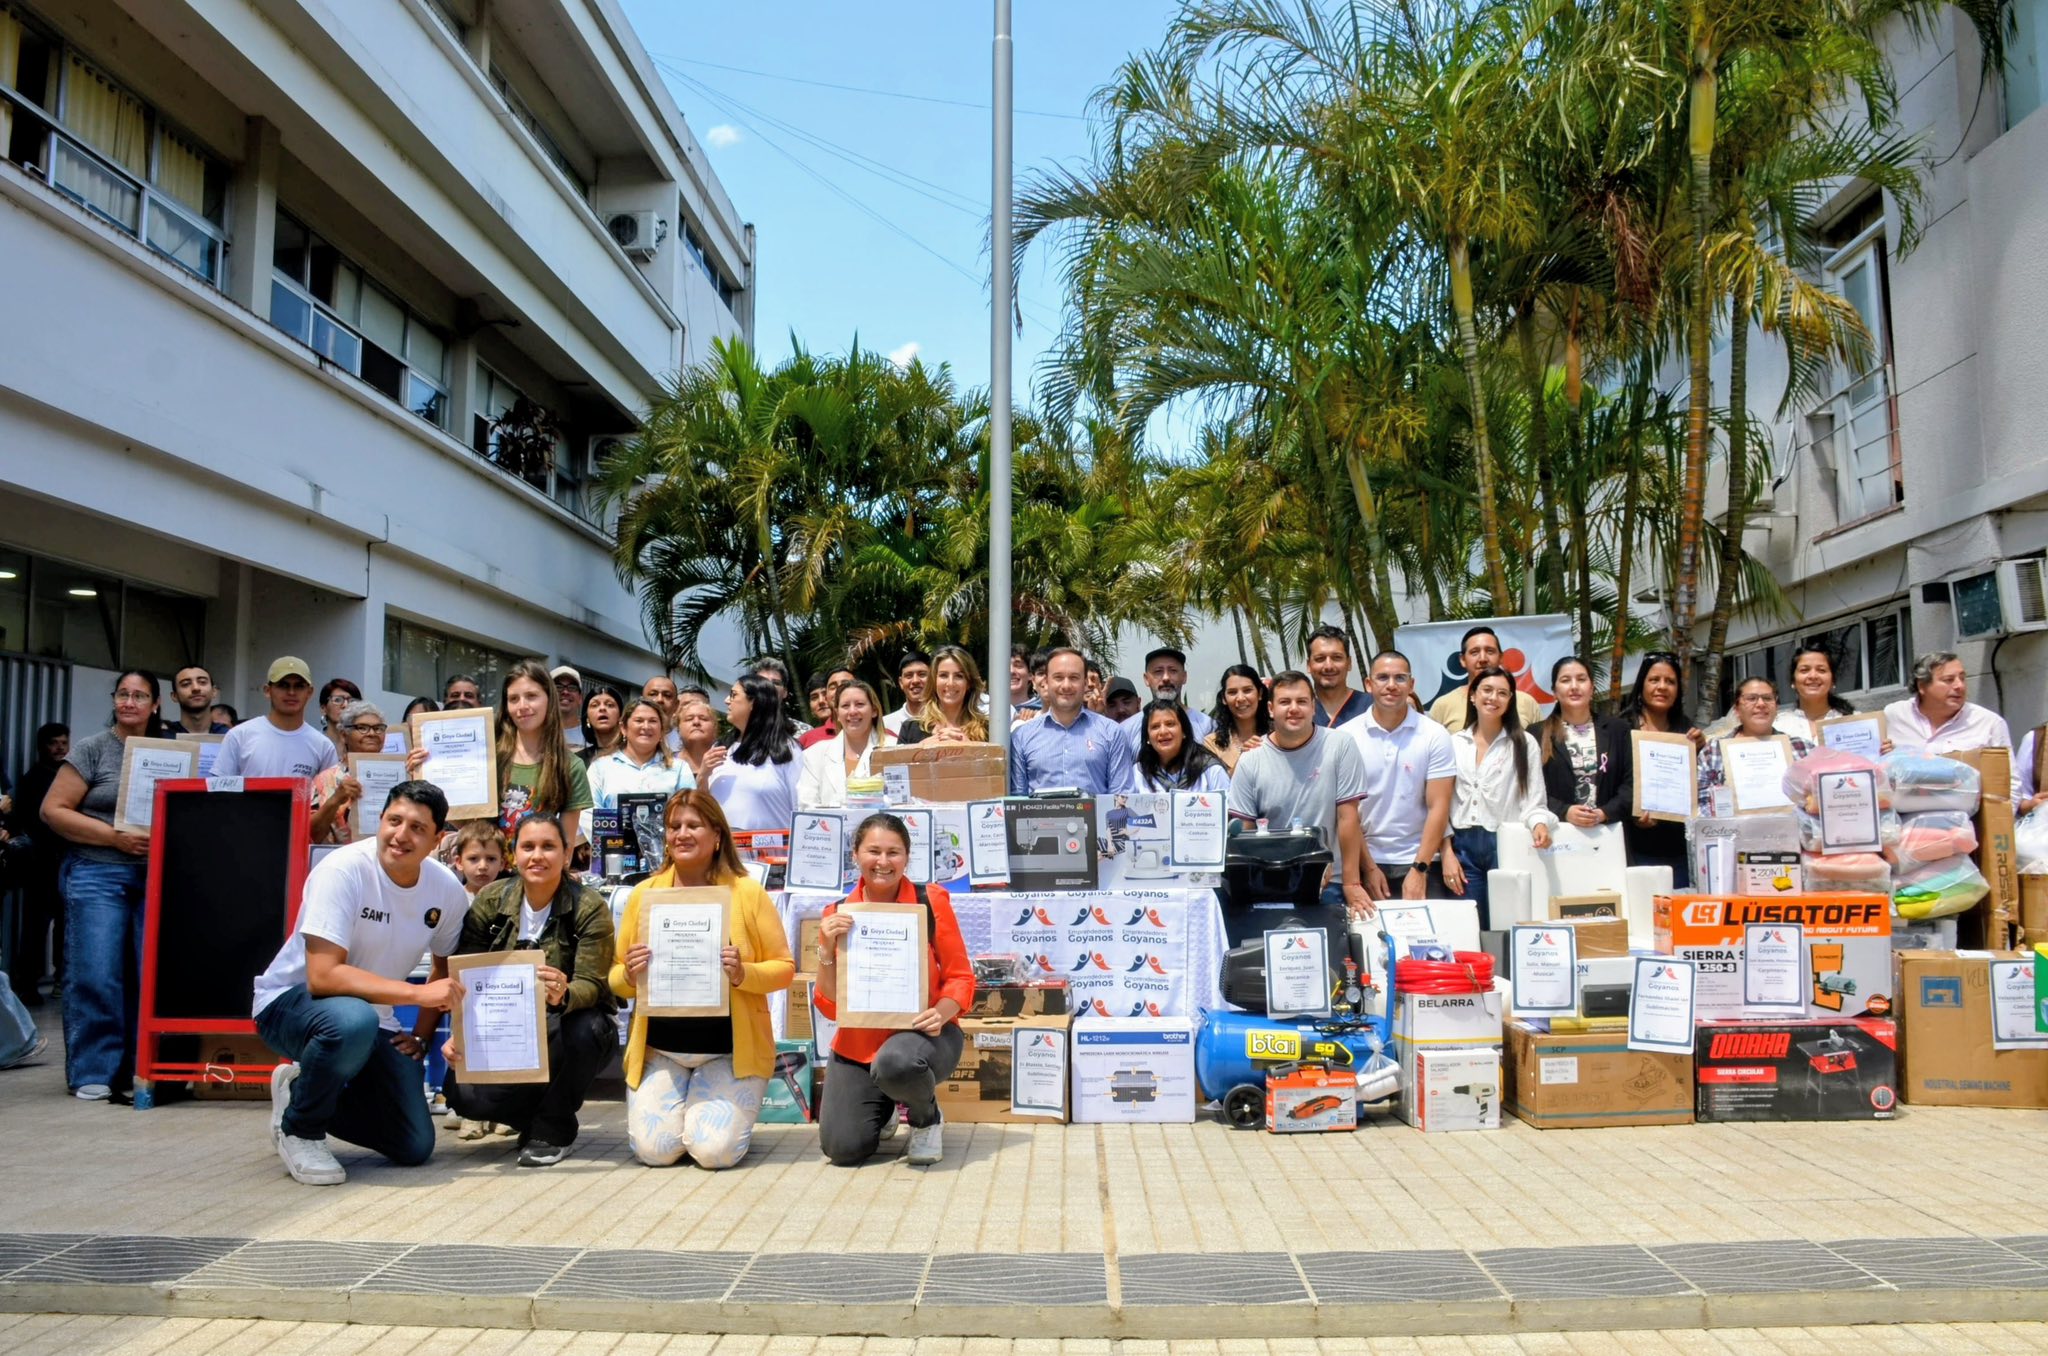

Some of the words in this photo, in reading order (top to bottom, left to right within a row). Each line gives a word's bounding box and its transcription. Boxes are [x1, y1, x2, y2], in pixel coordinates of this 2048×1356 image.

[1723, 901, 1881, 926] LÜSQTOFF
[673, 919, 687, 927] Goya
[688, 918, 708, 926] Ciudad
[885, 928, 905, 936] Ciudad
[1816, 926, 1844, 934] ABOUT
[1011, 934, 1057, 943] Goyanos
[1068, 933, 1114, 944] Goyanos
[1122, 934, 1168, 945] Goyanos
[1682, 950, 1735, 960] SIERRA
[485, 982, 501, 991] Goya
[501, 981, 520, 990] Ciudad
[1069, 979, 1114, 989] Goyanos
[1124, 980, 1169, 991] Goyanos
[1418, 999, 1475, 1008] BELARRA
[1251, 1033, 1290, 1054] bta
[1709, 1033, 1791, 1058] OMAHA
[1716, 1068, 1739, 1076] SIERRA
[1740, 1067, 1764, 1076] CIRCULAR
